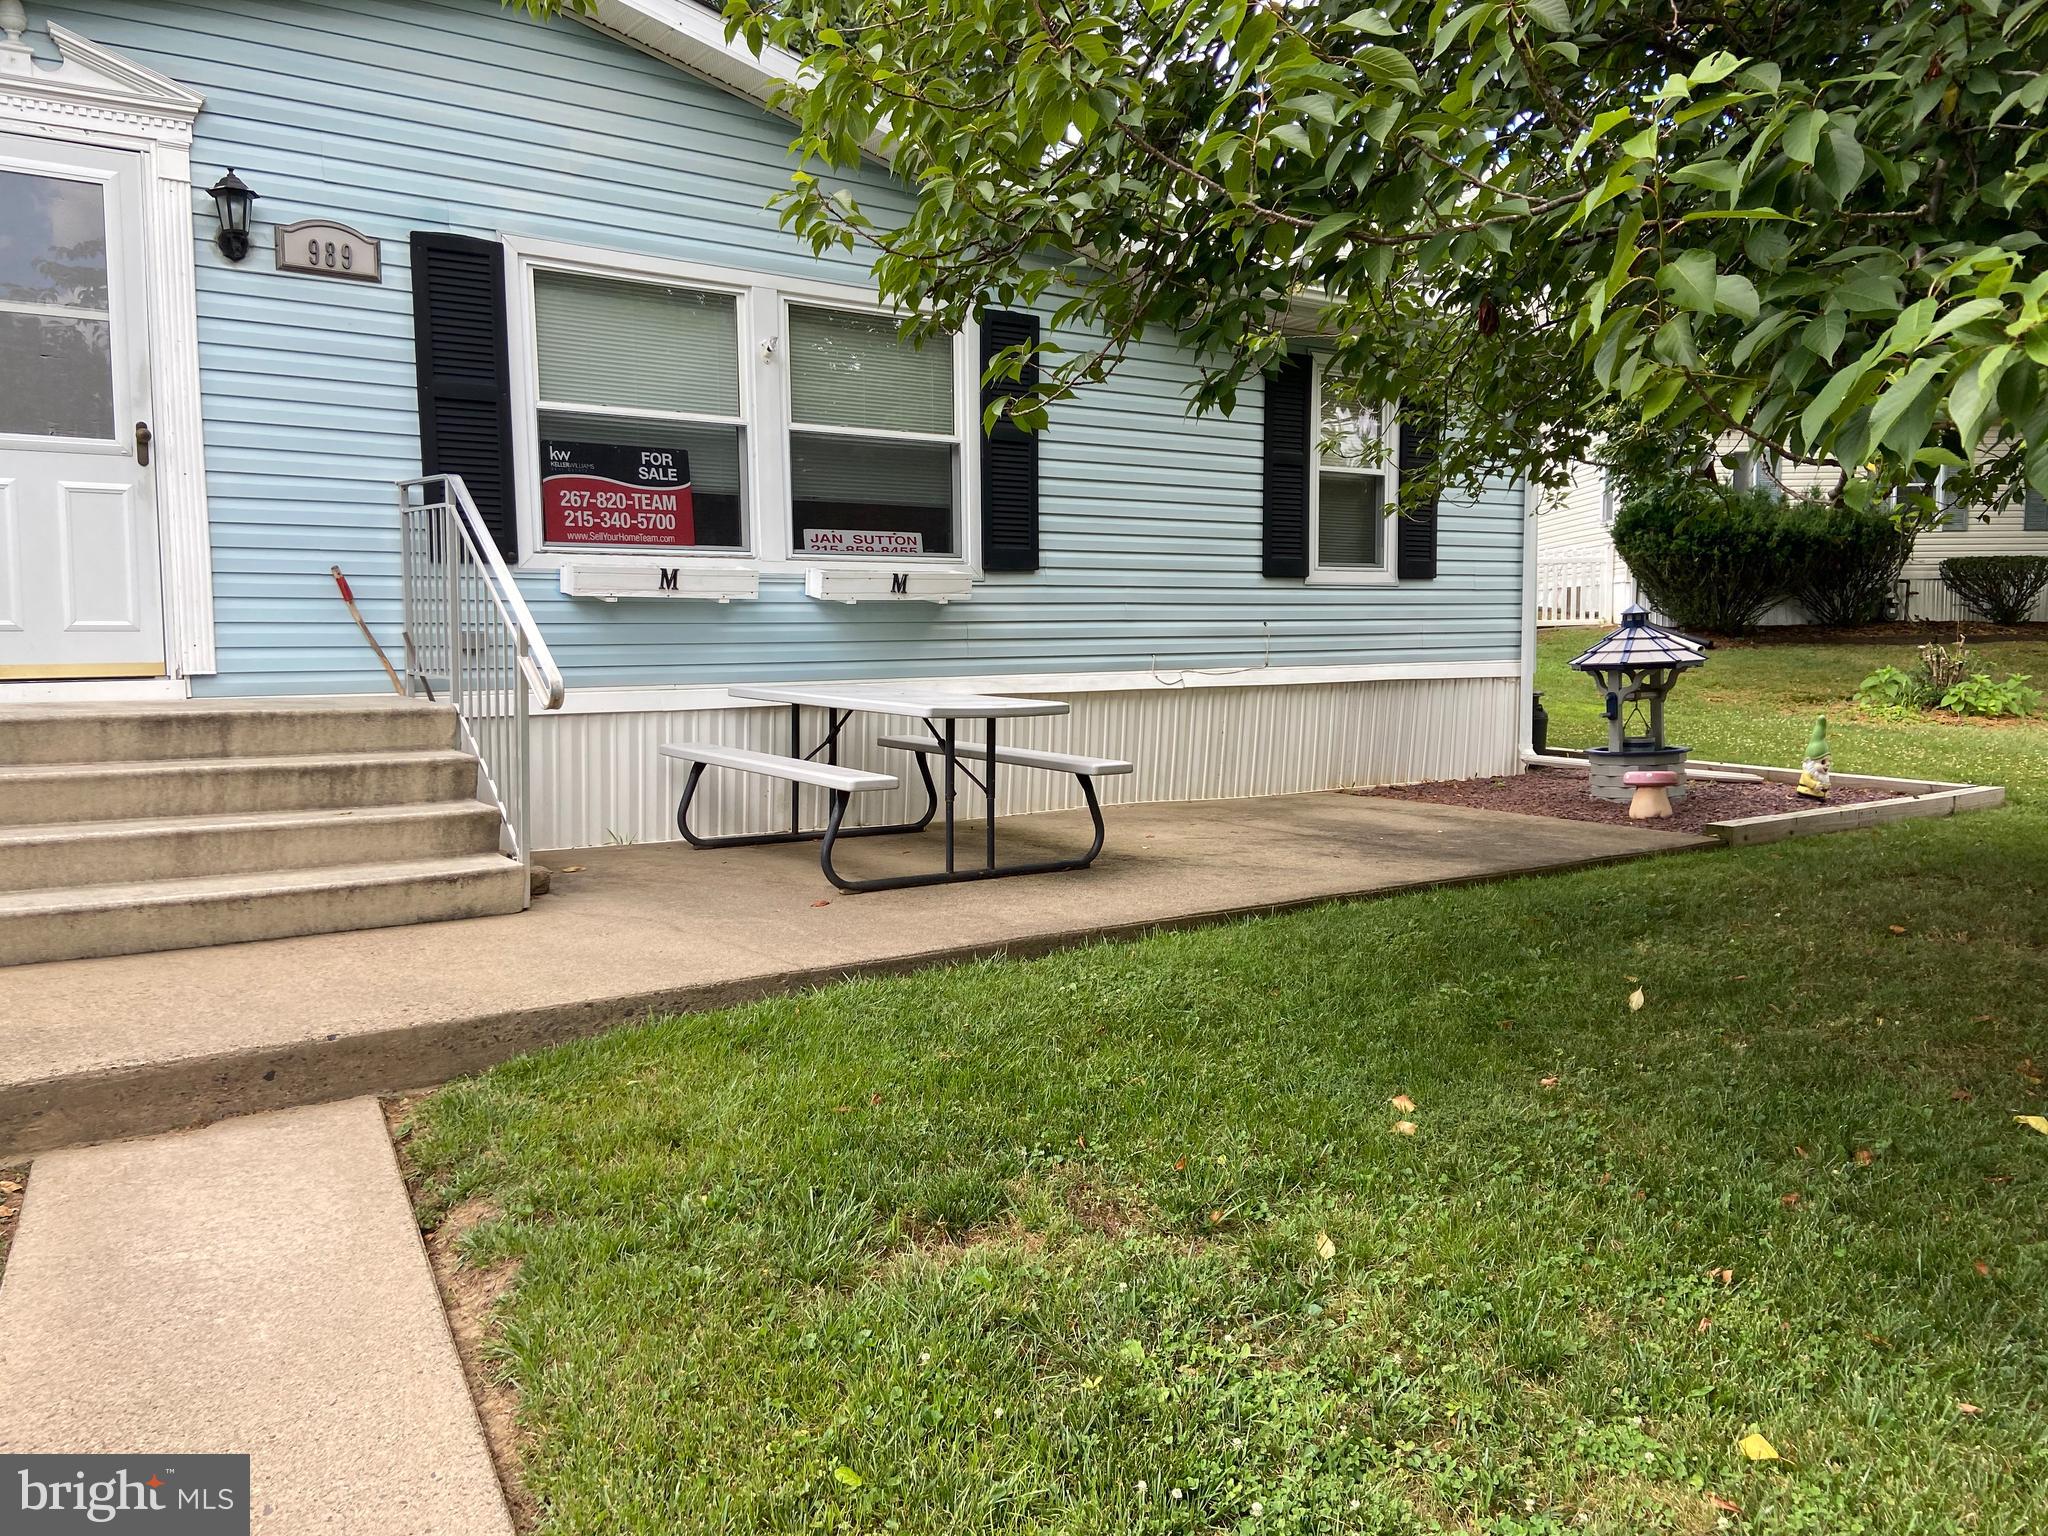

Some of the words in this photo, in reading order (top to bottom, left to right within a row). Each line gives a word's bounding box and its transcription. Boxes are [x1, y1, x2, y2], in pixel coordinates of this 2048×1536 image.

[308, 239, 352, 269] 989
[549, 445, 571, 461] kw
[641, 452, 673, 467] FOR
[638, 467, 678, 481] SALE
[559, 490, 677, 512] 267-820-TEAM
[564, 510, 676, 530] 215-340-5700
[567, 531, 676, 543] www.SellYourHomeTeam.com
[810, 533, 843, 544] JAN
[853, 534, 917, 546] SUTTON
[658, 567, 680, 591] M
[891, 572, 909, 594] M
